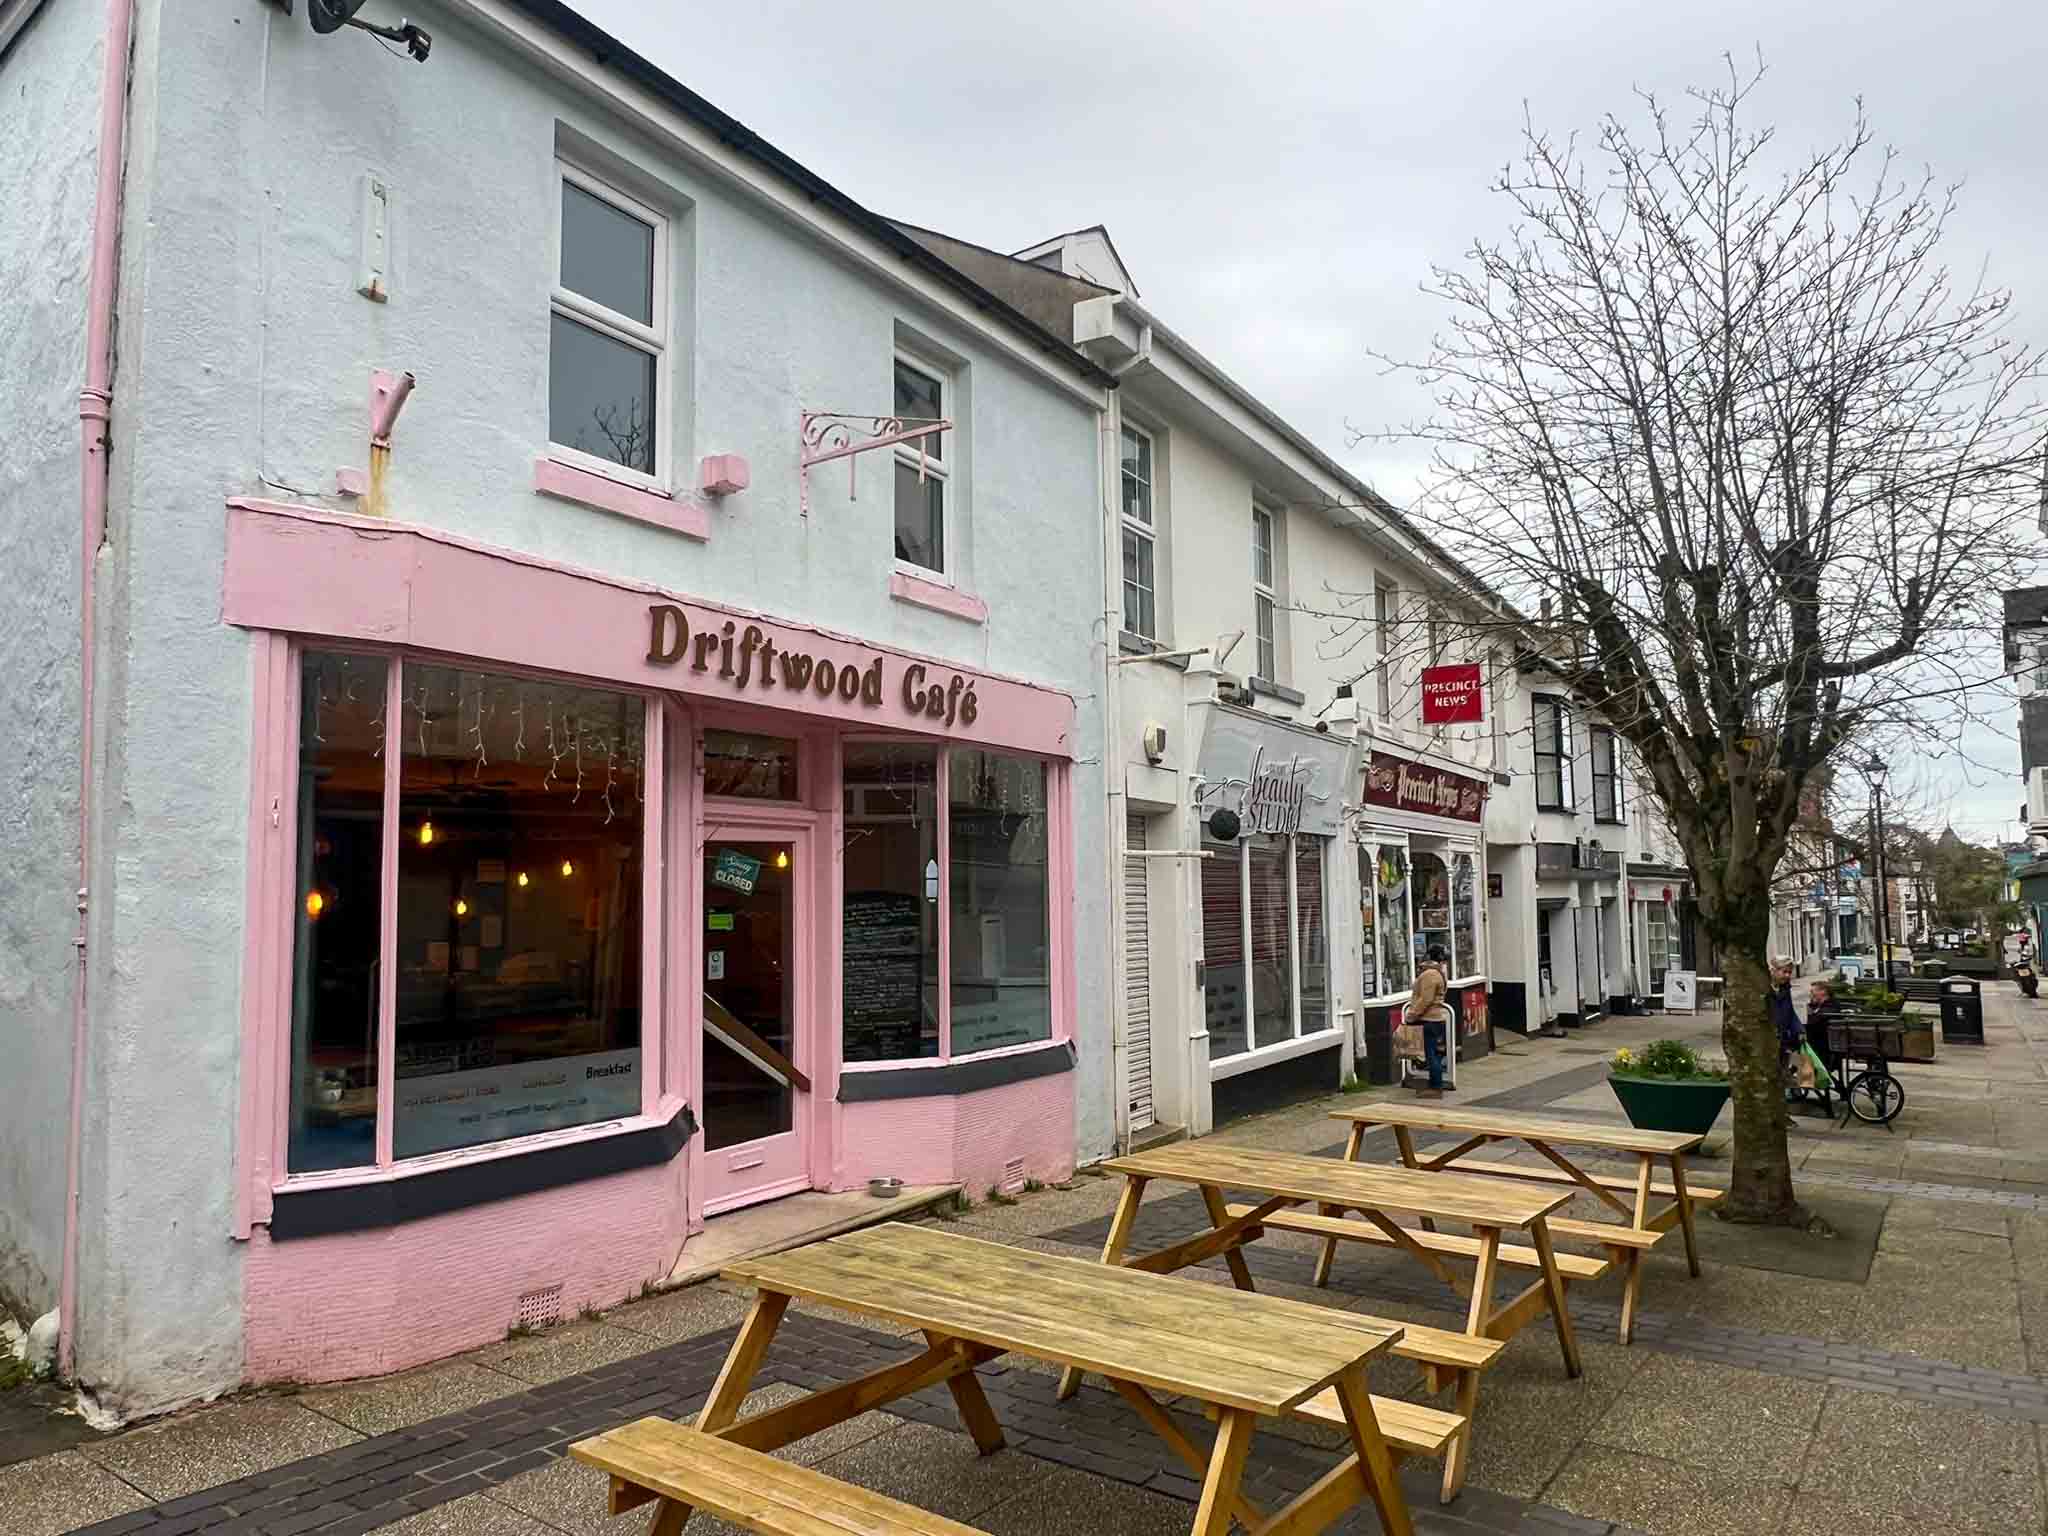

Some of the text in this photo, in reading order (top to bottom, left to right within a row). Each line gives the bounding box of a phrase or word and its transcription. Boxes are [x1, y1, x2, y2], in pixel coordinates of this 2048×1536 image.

[646, 604, 978, 728] Driftwood Café
[1425, 680, 1479, 694] PRECINCT
[1435, 695, 1468, 707] NEWS
[1250, 745, 1305, 832] beauty
[1248, 801, 1302, 836] STUDIO
[715, 870, 753, 890] CLOSED
